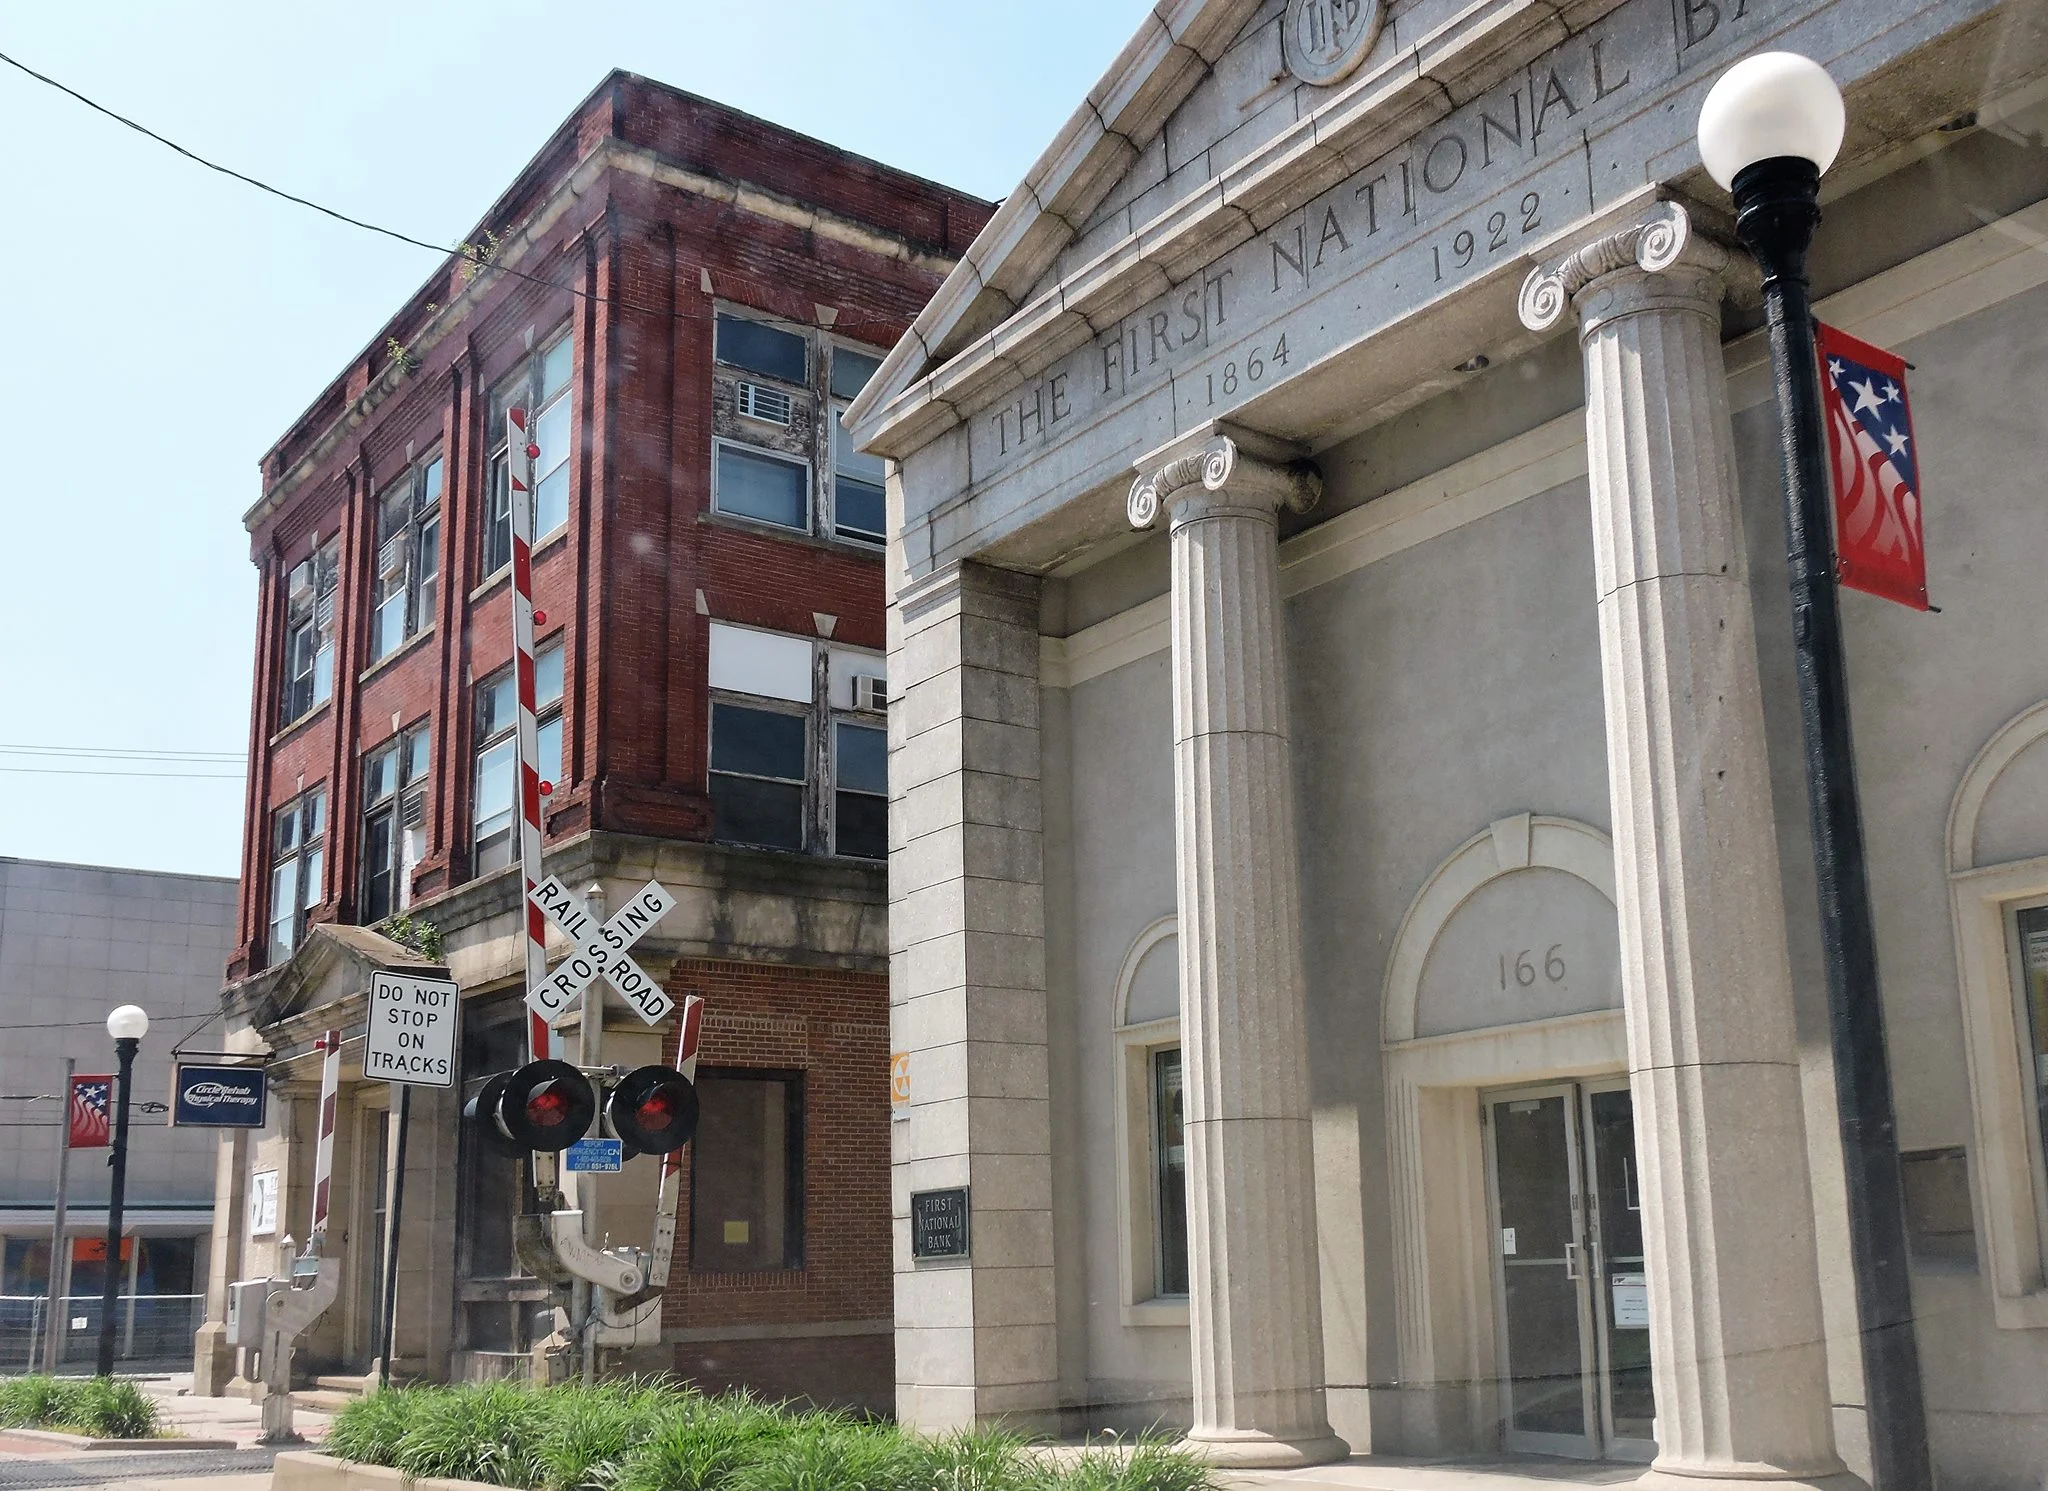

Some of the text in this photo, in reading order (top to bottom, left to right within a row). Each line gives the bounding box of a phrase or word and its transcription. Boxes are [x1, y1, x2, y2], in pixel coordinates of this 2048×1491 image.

[991, 371, 1073, 457] THE
[1101, 268, 1233, 396] FIRST
[1268, 38, 1630, 294] NATIONAL
[1432, 190, 1542, 283] 1922
[1206, 331, 1291, 408] 1864
[535, 881, 588, 941] RAIL
[538, 893, 664, 1009] CROSSING
[1499, 943, 1566, 991] 166
[378, 983, 451, 1008] DO NOT
[608, 958, 666, 1017] ROAD
[387, 1007, 438, 1028] STOP
[398, 1031, 425, 1050] ON
[372, 1051, 447, 1074] TRACKS
[196, 1085, 251, 1095] Circle Rehab
[222, 1094, 258, 1106] Therapy
[925, 1197, 953, 1213] FIRST
[919, 1215, 960, 1231] NATIONAL
[928, 1234, 952, 1249] BANK
